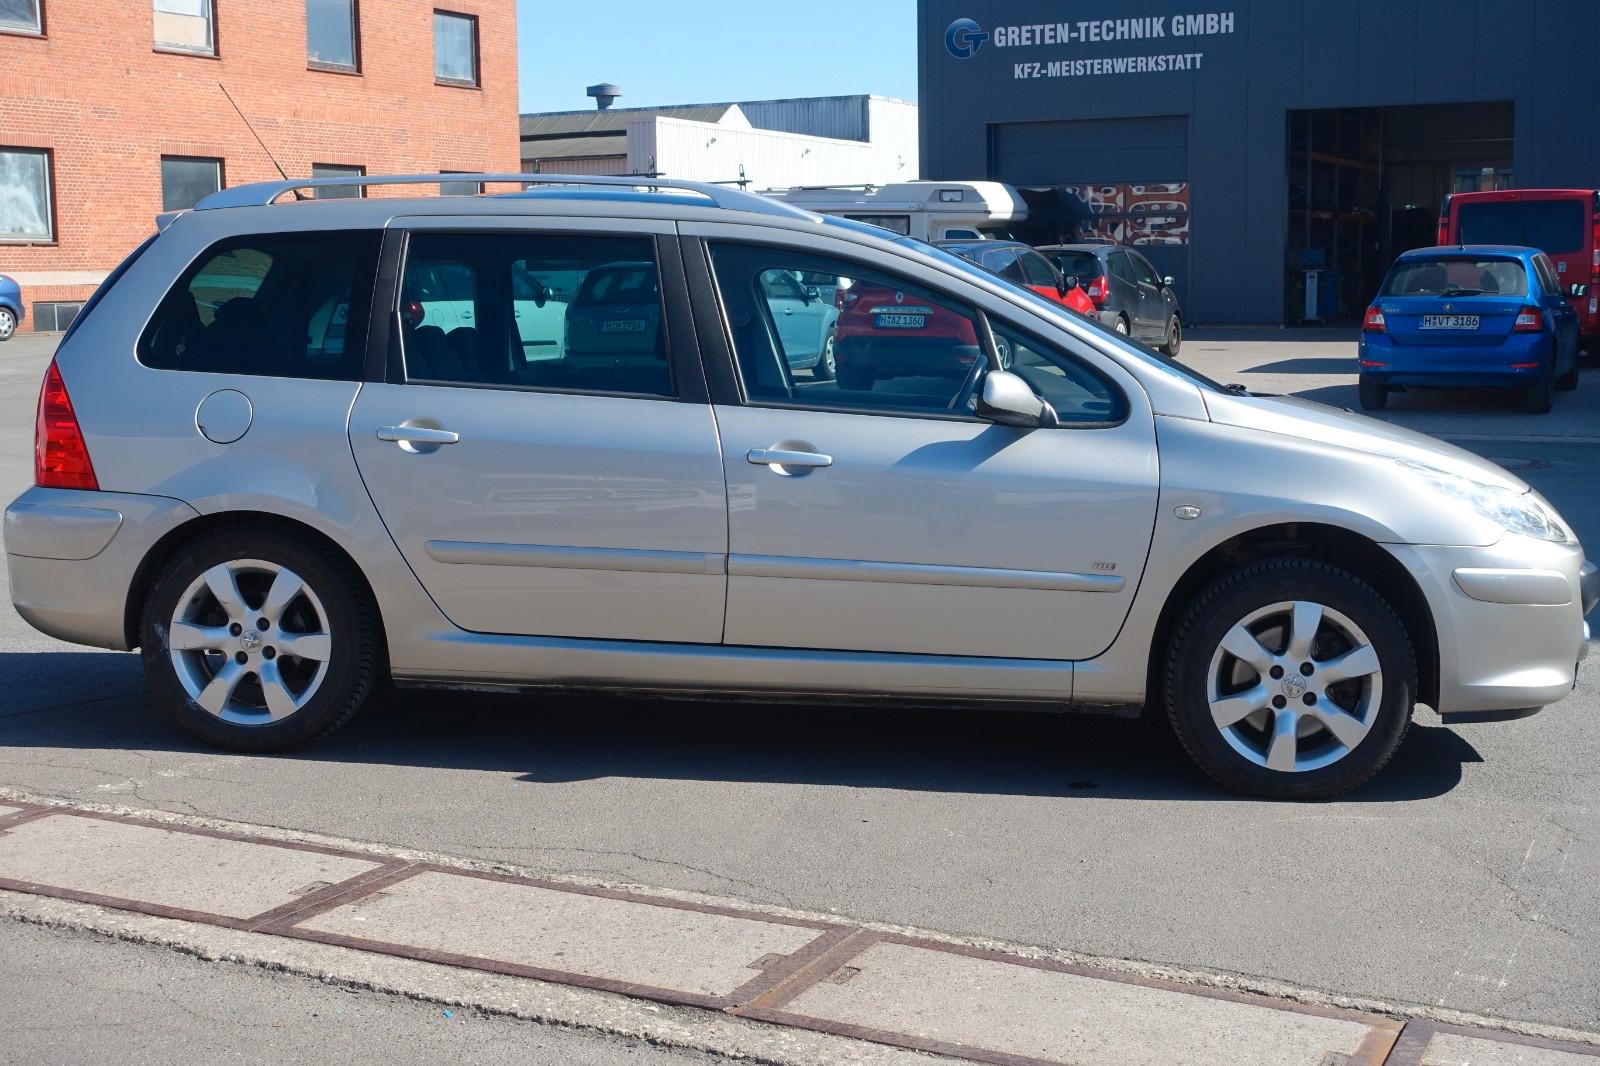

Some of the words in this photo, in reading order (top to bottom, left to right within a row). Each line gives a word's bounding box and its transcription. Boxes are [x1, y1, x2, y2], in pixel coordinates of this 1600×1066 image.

[994, 16, 1166, 47] GRETEN-TECHNIK
[1171, 12, 1234, 36] GMBH
[1014, 53, 1204, 79] KFZ-MEISTERWERKSTATT
[1453, 316, 1479, 326] 3186
